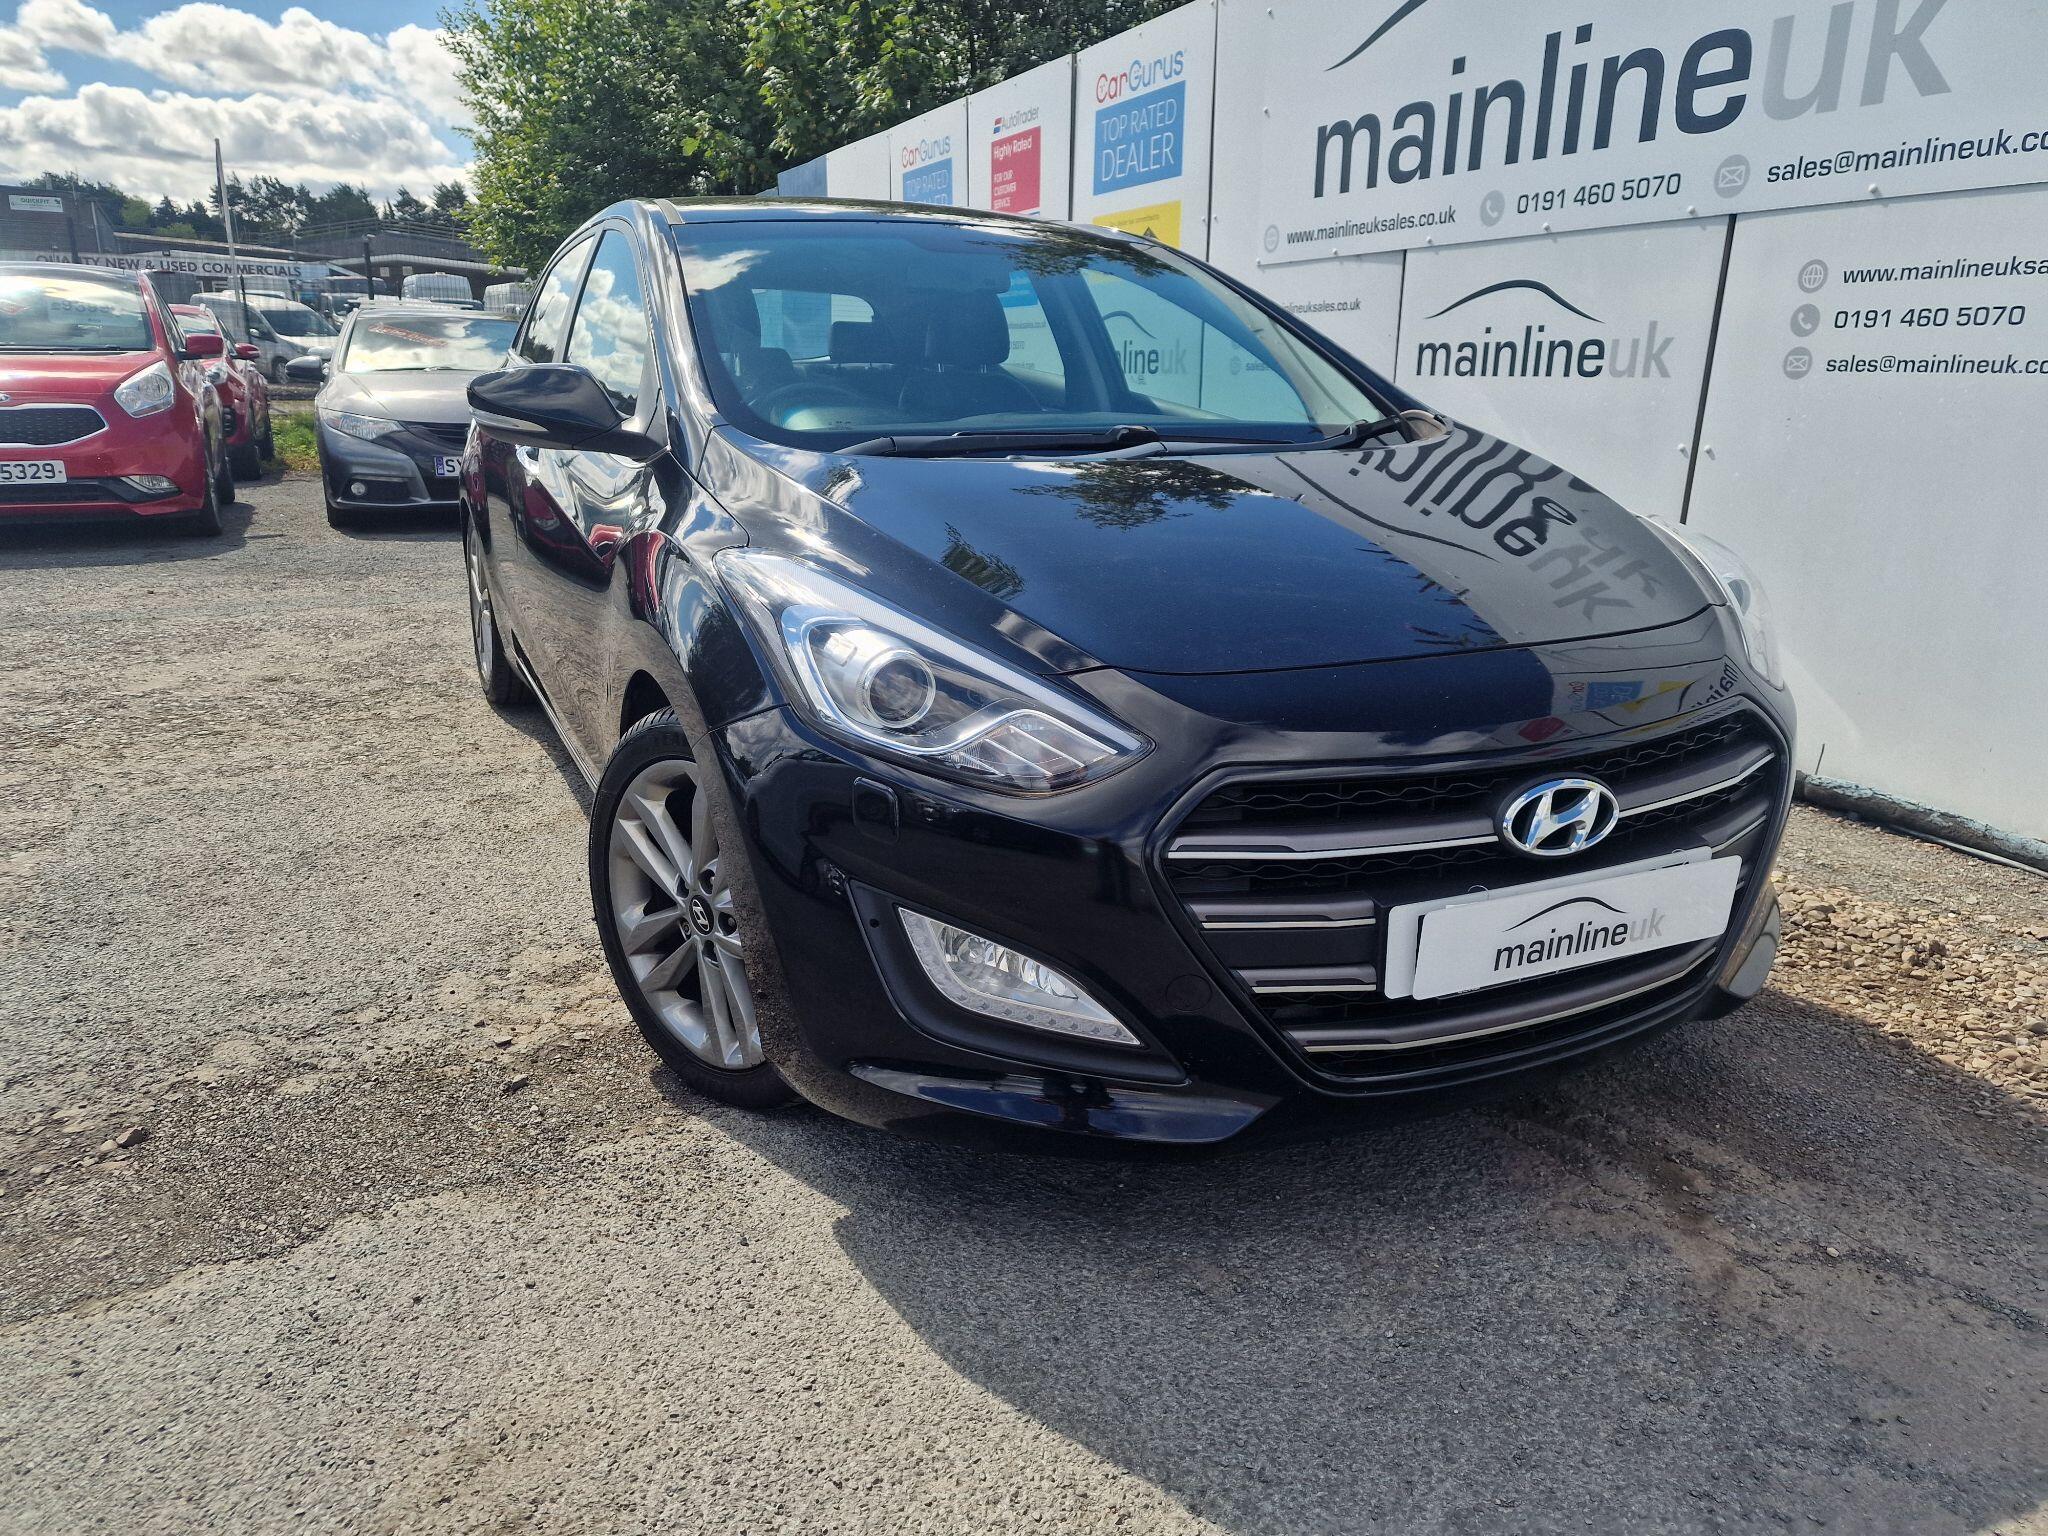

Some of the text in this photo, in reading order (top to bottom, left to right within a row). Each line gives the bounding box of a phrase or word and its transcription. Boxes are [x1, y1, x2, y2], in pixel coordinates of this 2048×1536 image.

[1096, 50, 1184, 103] CarGurus
[1102, 98, 1177, 142] TOP RATED
[1313, 0, 1951, 198] mainlineuk
[902, 136, 950, 168] CarGurus
[1102, 132, 1174, 181] DEALER
[1517, 173, 1682, 214] 0191 460 5070
[1286, 205, 1455, 244] www.mainlineuksales.co.uk
[106, 258, 140, 271] NEW
[146, 259, 157, 270] &
[160, 260, 197, 273] USED
[1834, 305, 2026, 329] 0191 460 5070
[1416, 321, 1675, 378] mainlineuk
[0, 463, 56, 480] 5329
[1493, 908, 1665, 971] mainlineuk
